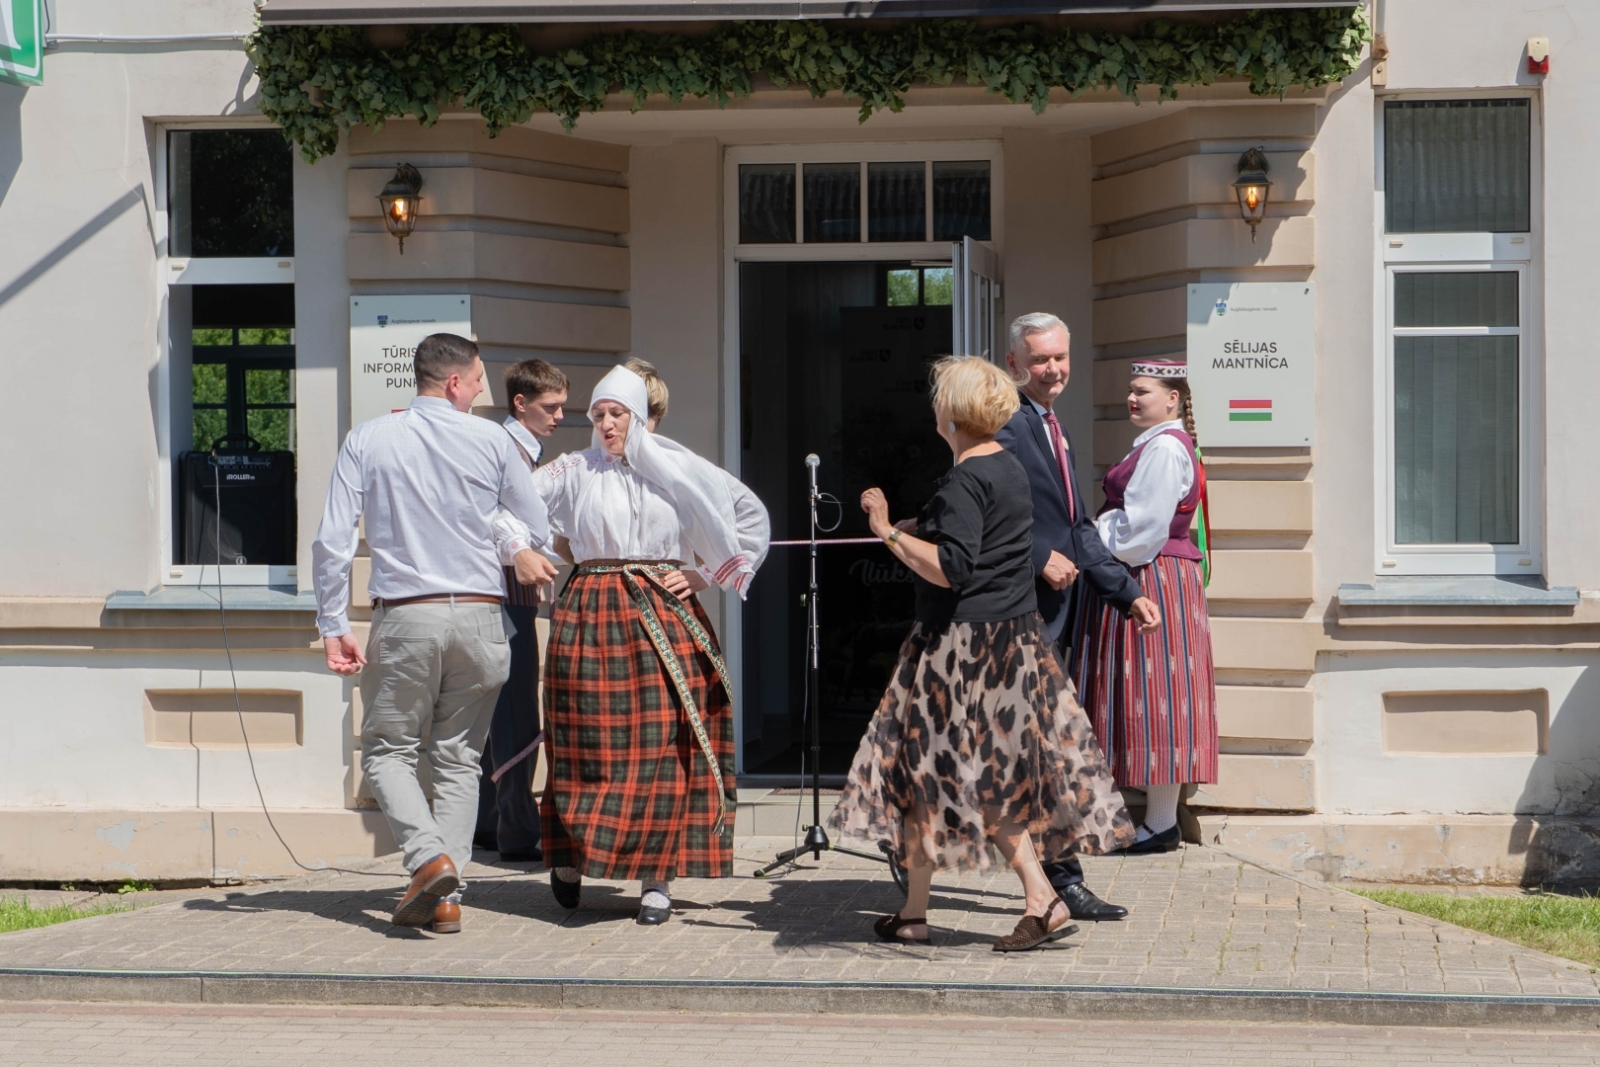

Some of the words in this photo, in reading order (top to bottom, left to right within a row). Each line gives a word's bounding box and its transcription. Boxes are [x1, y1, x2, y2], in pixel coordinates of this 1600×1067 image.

[382, 345, 417, 358] TŪRIS
[1223, 339, 1278, 354] SĒLIJAS
[363, 362, 415, 374] INFORM
[1212, 354, 1289, 369] MANTNĪCA
[848, 558, 915, 587] Ilūks
